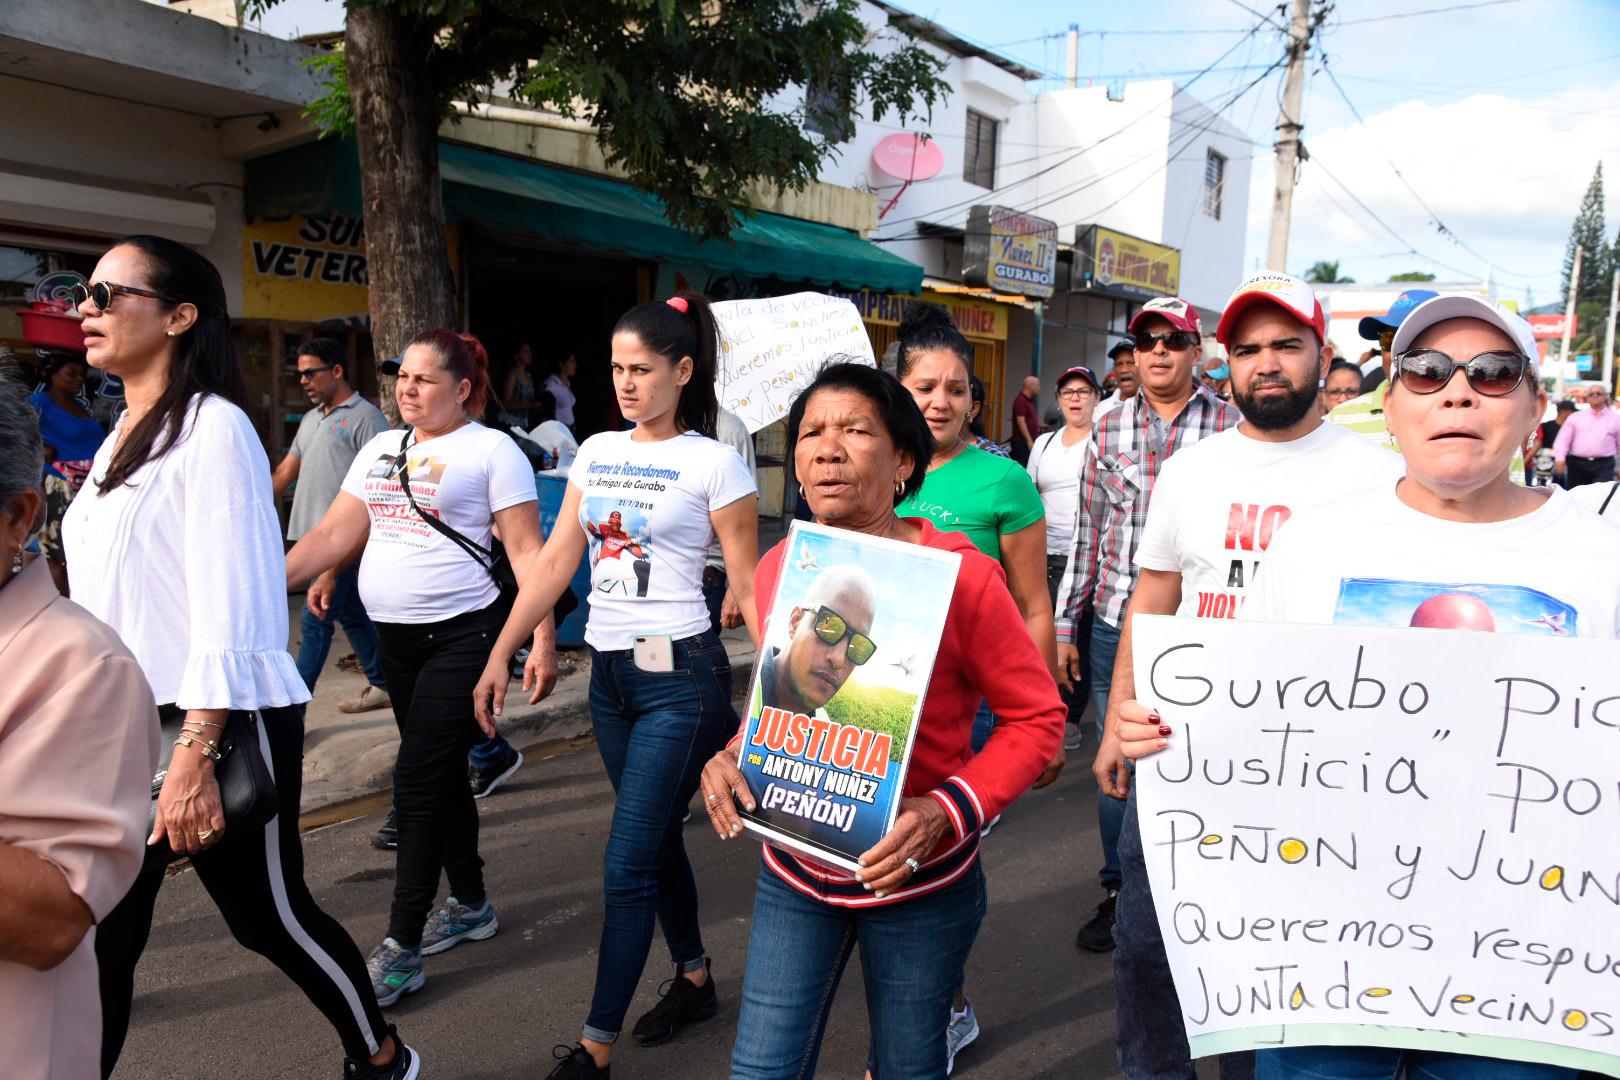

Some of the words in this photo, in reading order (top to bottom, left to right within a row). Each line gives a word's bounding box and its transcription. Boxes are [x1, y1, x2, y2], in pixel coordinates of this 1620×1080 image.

[252, 241, 369, 286] VETER
[995, 264, 1050, 285] GURABO
[952, 304, 996, 334] NUÑEZ
[586, 460, 613, 476] Siempre
[621, 461, 681, 482] Recordaremos
[595, 477, 622, 489] Amigos
[622, 479, 633, 489] de
[633, 479, 666, 493] Gurabo
[1225, 503, 1292, 552] NO
[1227, 559, 1244, 588] A
[1196, 592, 1247, 620] VIOL
[1150, 643, 1429, 715] Gurabo
[750, 705, 893, 779] JUSTICIA
[747, 753, 763, 766] POR
[761, 754, 826, 789] ANTONY
[823, 769, 880, 804] NUÑEZ
[1487, 762, 1620, 834] Po
[761, 782, 857, 832] (PEÑÓN)
[1386, 844, 1422, 901] y
[1173, 901, 1435, 951] Queremos
[1324, 960, 1393, 1015] de
